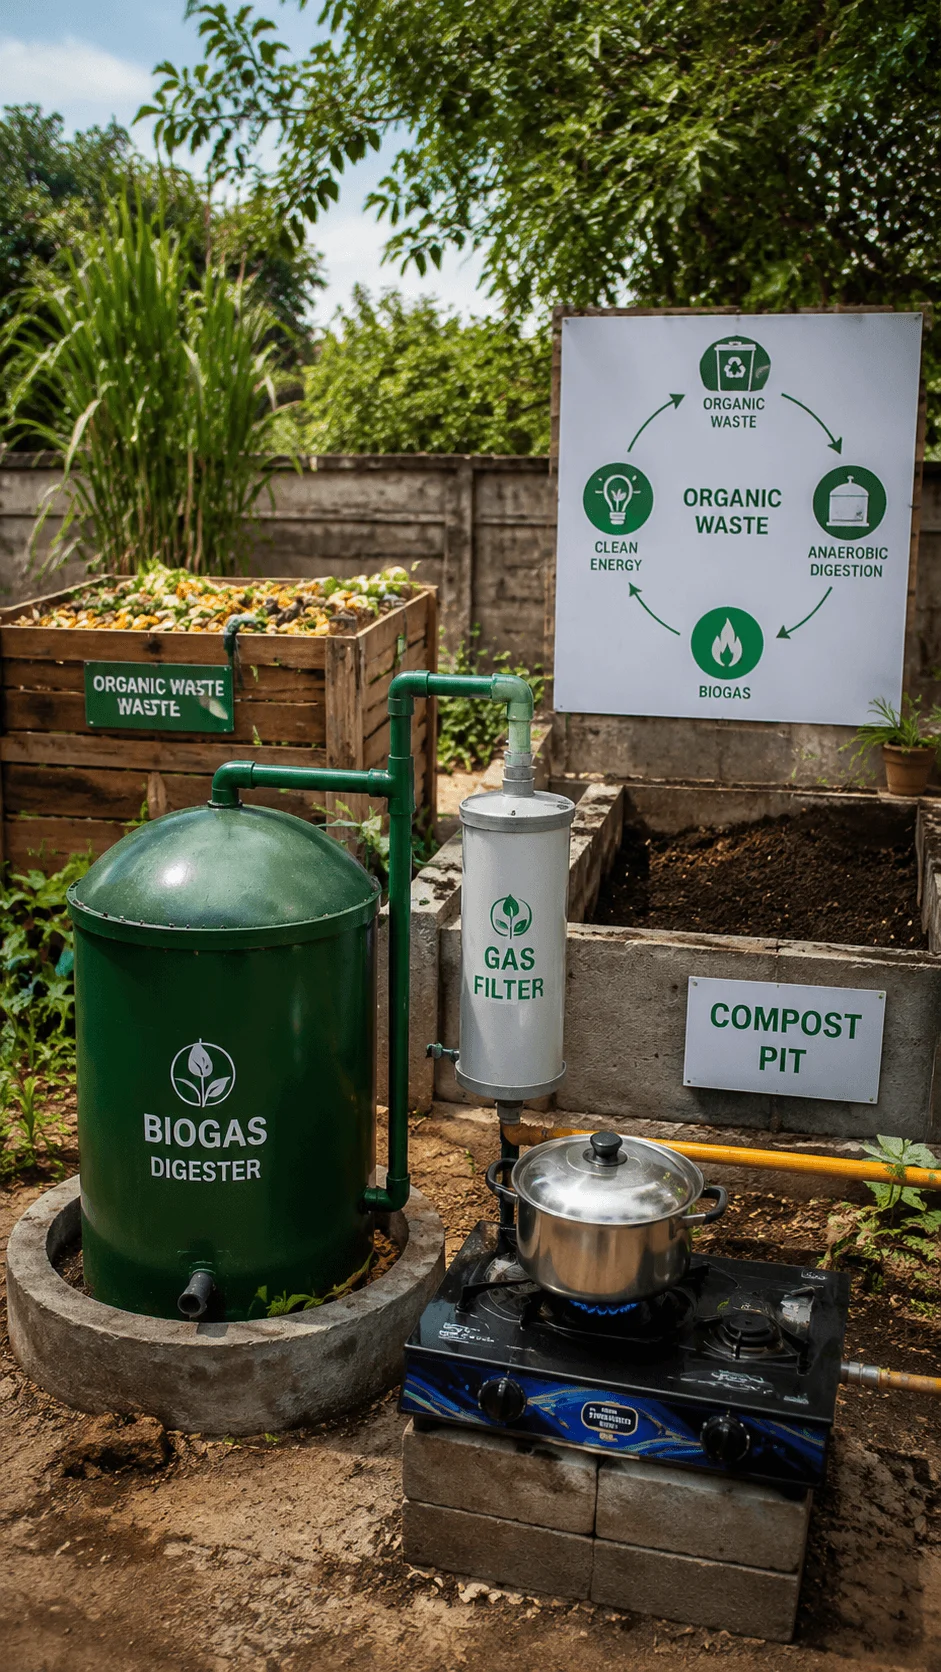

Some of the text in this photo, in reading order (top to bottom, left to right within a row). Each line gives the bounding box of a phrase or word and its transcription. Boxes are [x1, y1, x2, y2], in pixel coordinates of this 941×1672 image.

[703, 397, 765, 411] ORGANIC
[711, 415, 757, 429] WASTE
[683, 488, 782, 508] ORGANIC
[695, 516, 769, 535] WASTE
[594, 541, 638, 554] CLEAN
[808, 546, 889, 560] ANAEROBIC
[590, 558, 642, 571] ENERGY
[810, 564, 883, 578] DIGESTION
[93, 675, 225, 697] ORGANIC WASTE
[699, 685, 751, 700] BIOGAS
[117, 698, 181, 717] WASTE
[484, 946, 536, 971] GAS
[474, 975, 544, 1000] FILTER
[710, 1002, 863, 1040] COMPOST
[759, 1045, 807, 1074] PIT
[144, 1113, 268, 1148] BIOGAS
[150, 1156, 262, 1182] DIGESTER
